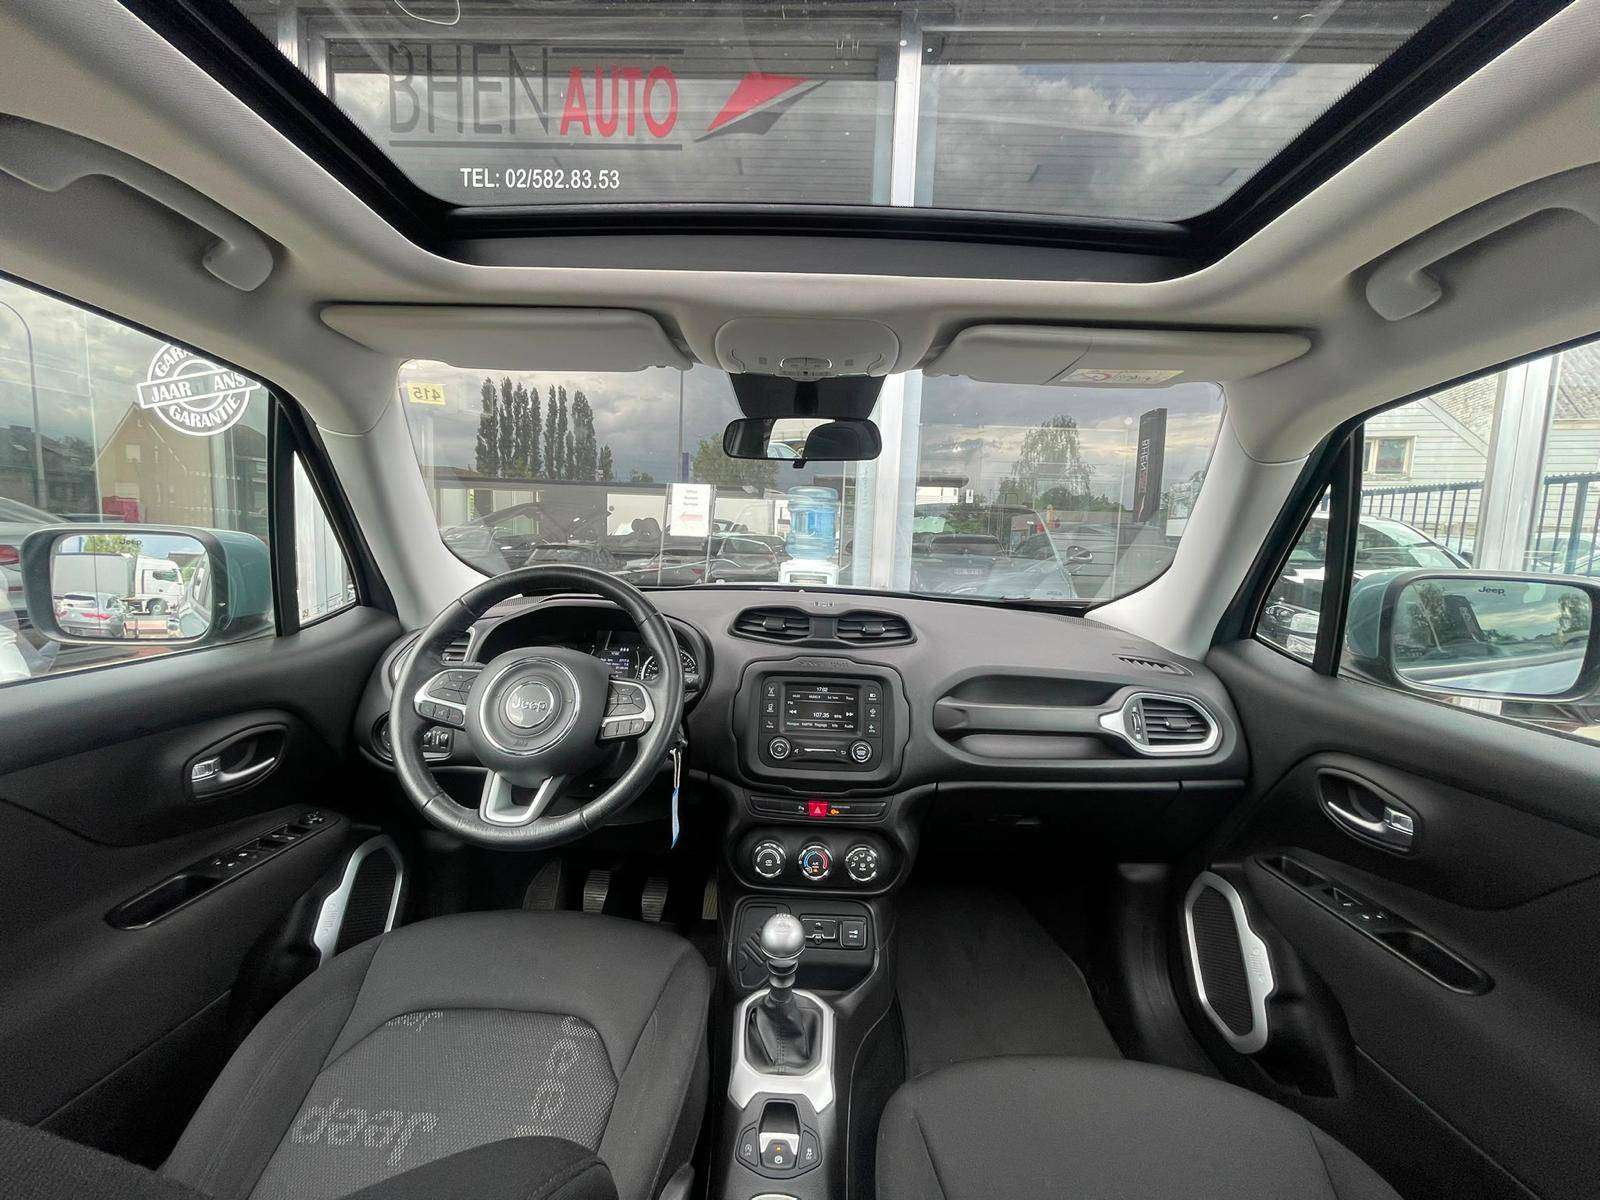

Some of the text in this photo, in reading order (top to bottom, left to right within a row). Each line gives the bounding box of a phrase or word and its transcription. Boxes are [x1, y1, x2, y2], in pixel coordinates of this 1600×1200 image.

[559, 64, 680, 138] AUTO
[459, 168, 621, 189] TEL: 02/582.83.53
[151, 372, 247, 403] JAAR ANS
[169, 393, 241, 428] GARANTIE
[1478, 585, 1505, 596] Jeep
[511, 695, 547, 712] Jeep
